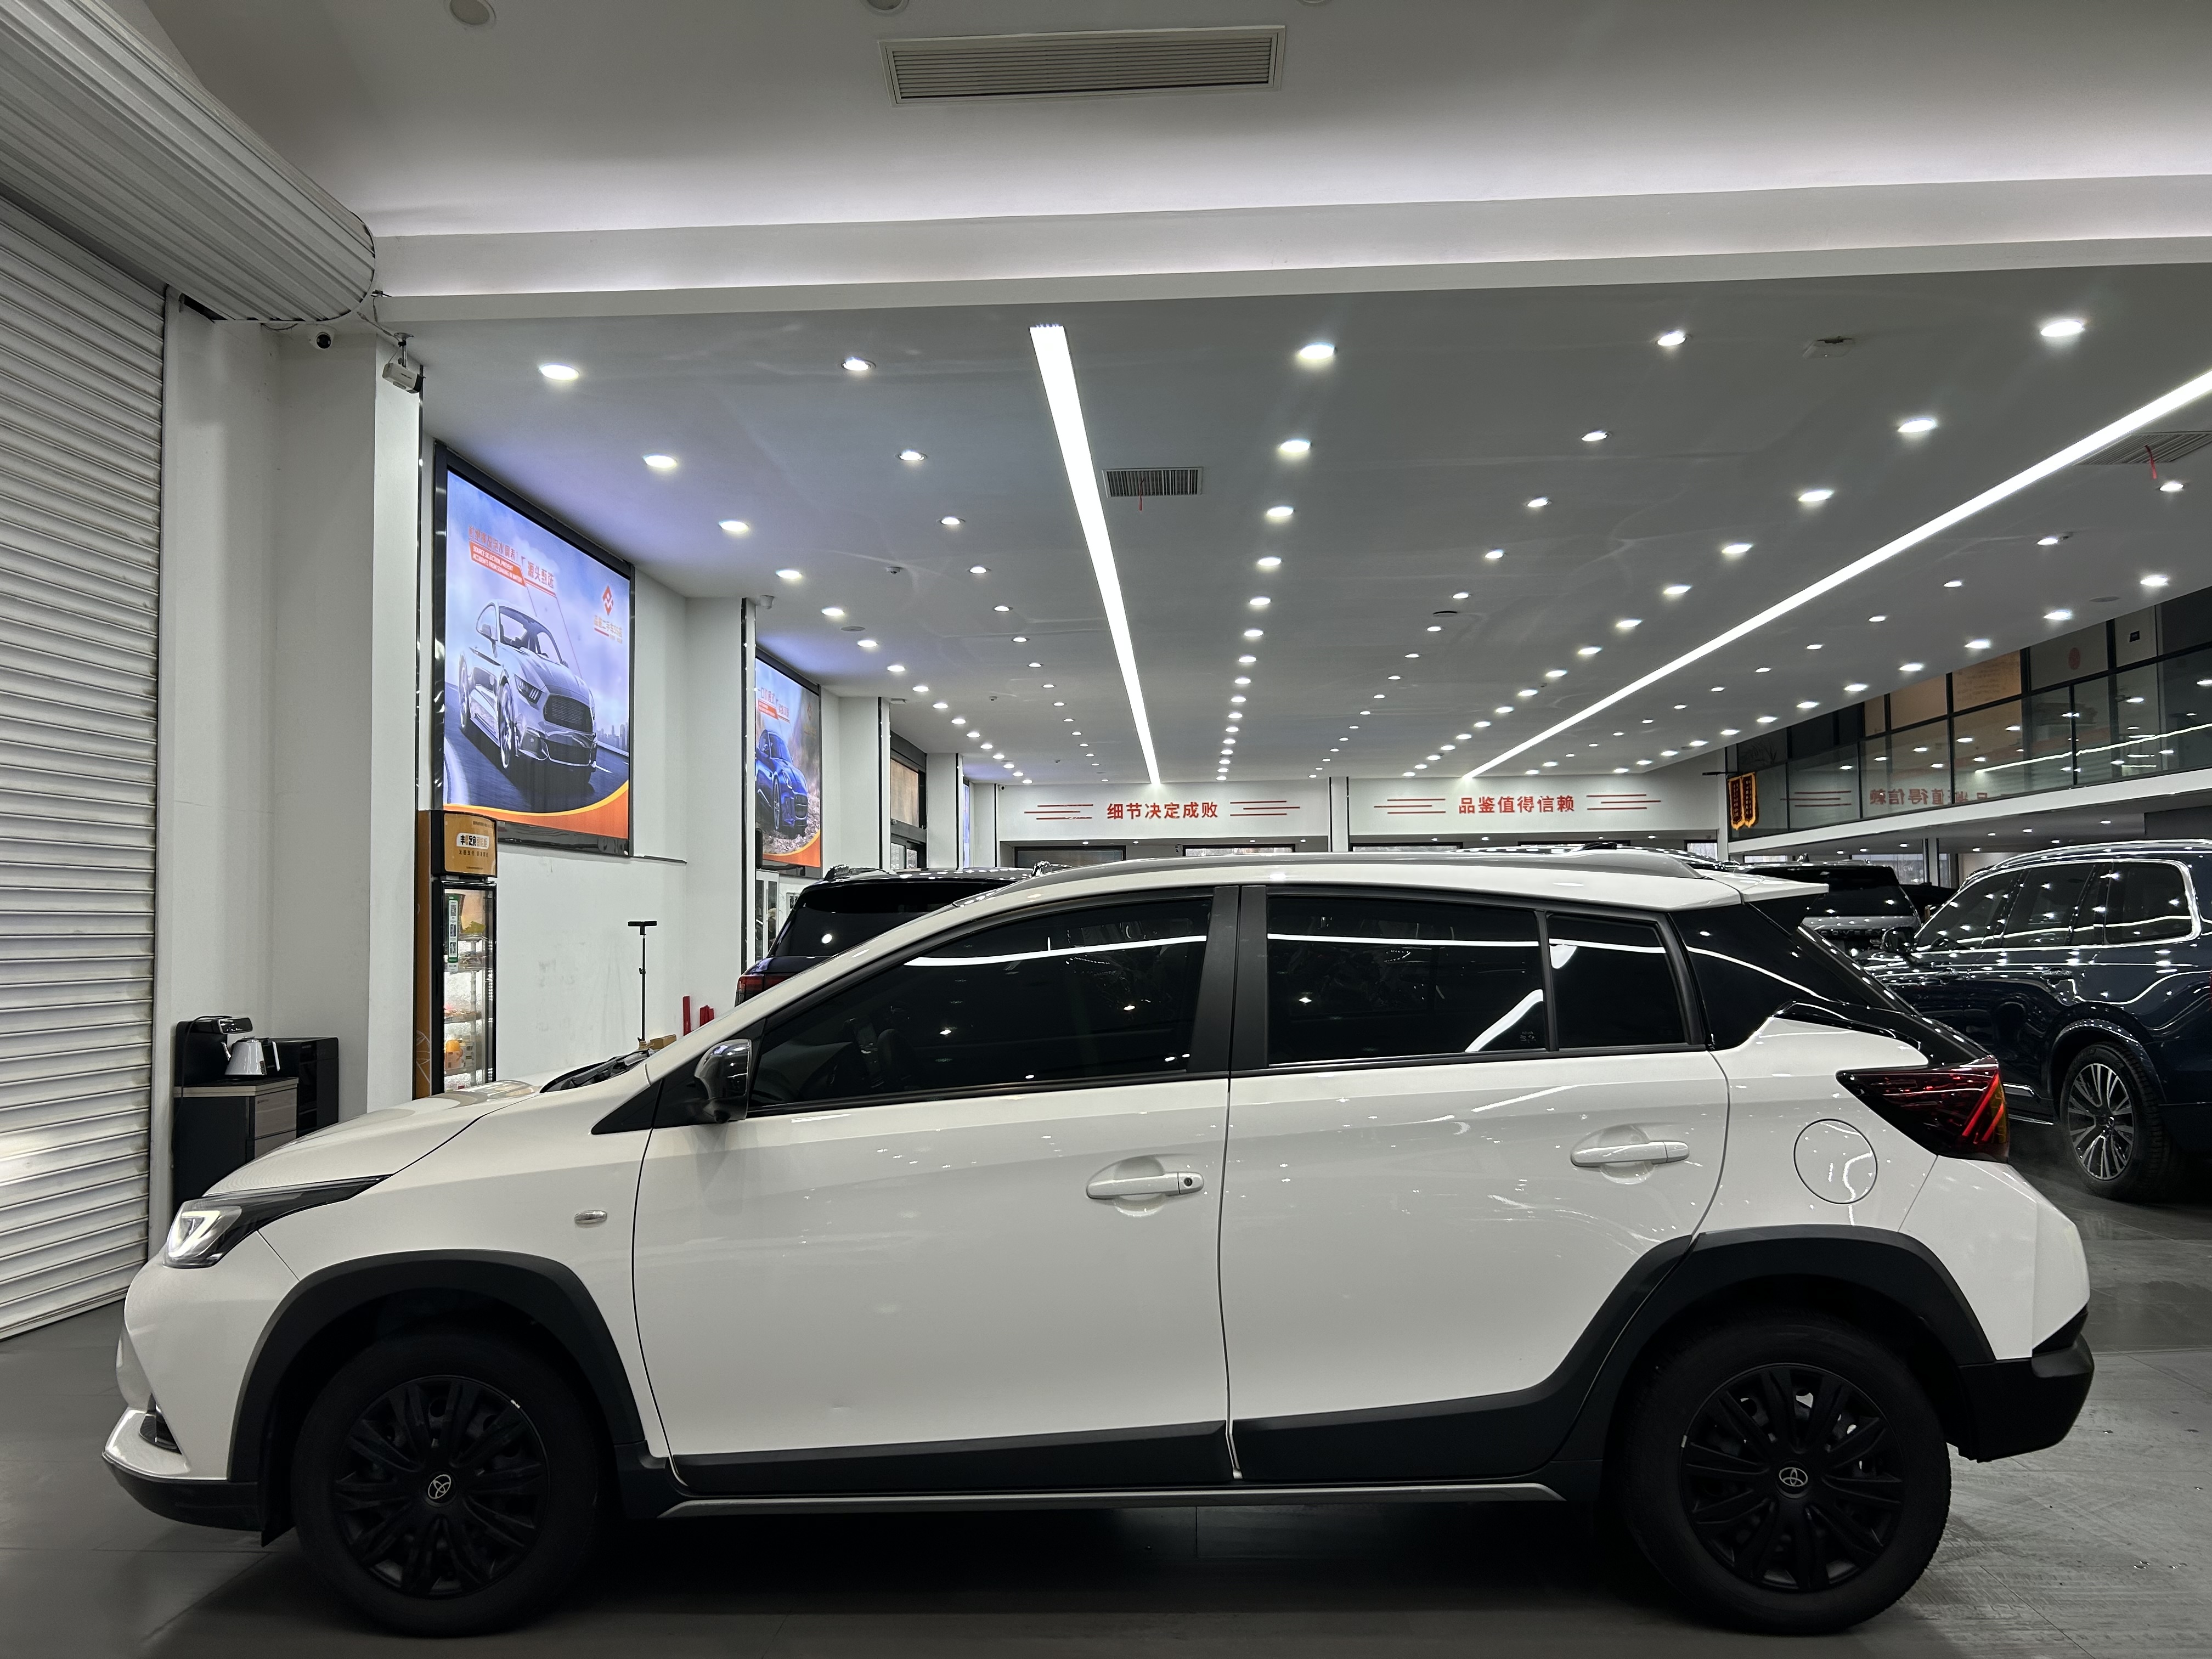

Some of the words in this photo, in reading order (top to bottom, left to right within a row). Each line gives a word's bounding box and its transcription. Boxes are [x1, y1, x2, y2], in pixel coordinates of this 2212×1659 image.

[1107, 802, 1219, 820] 细节决定成败
[1458, 794, 1576, 815] 品鉴值得信赖
